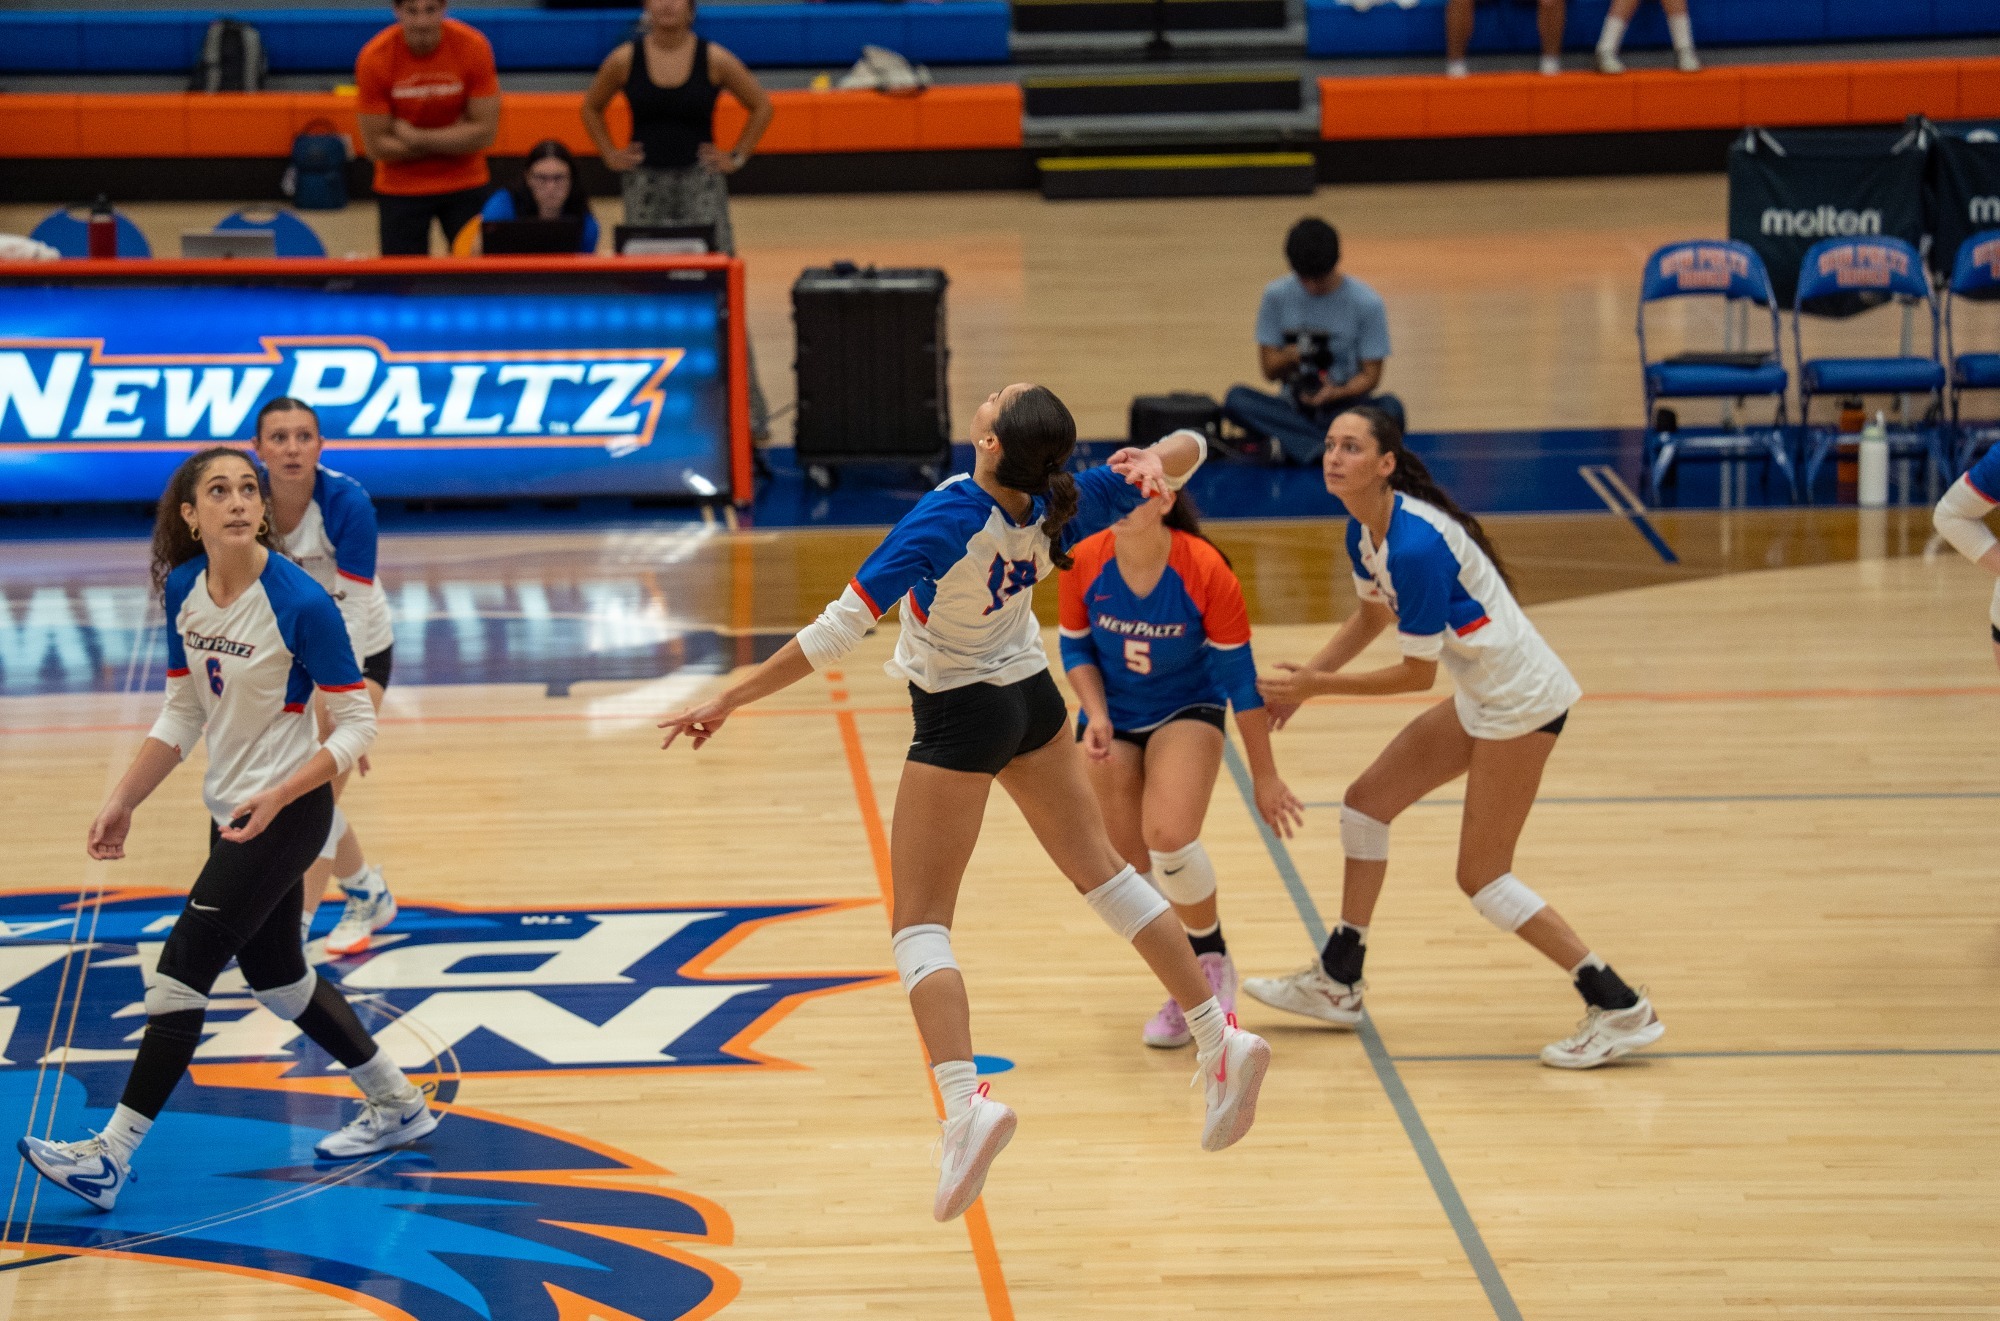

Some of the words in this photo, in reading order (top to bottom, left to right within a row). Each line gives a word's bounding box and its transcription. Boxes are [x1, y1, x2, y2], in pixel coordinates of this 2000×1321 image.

[1760, 206, 1881, 237] molten
[0, 351, 274, 438] NEW
[286, 349, 652, 435] PALTZ
[1098, 614, 1135, 633] NEW
[1132, 621, 1183, 637] PALTZ
[188, 632, 215, 650] NEW
[213, 638, 252, 657] PALTZ
[1124, 639, 1152, 675] 5
[206, 657, 224, 698] 6
